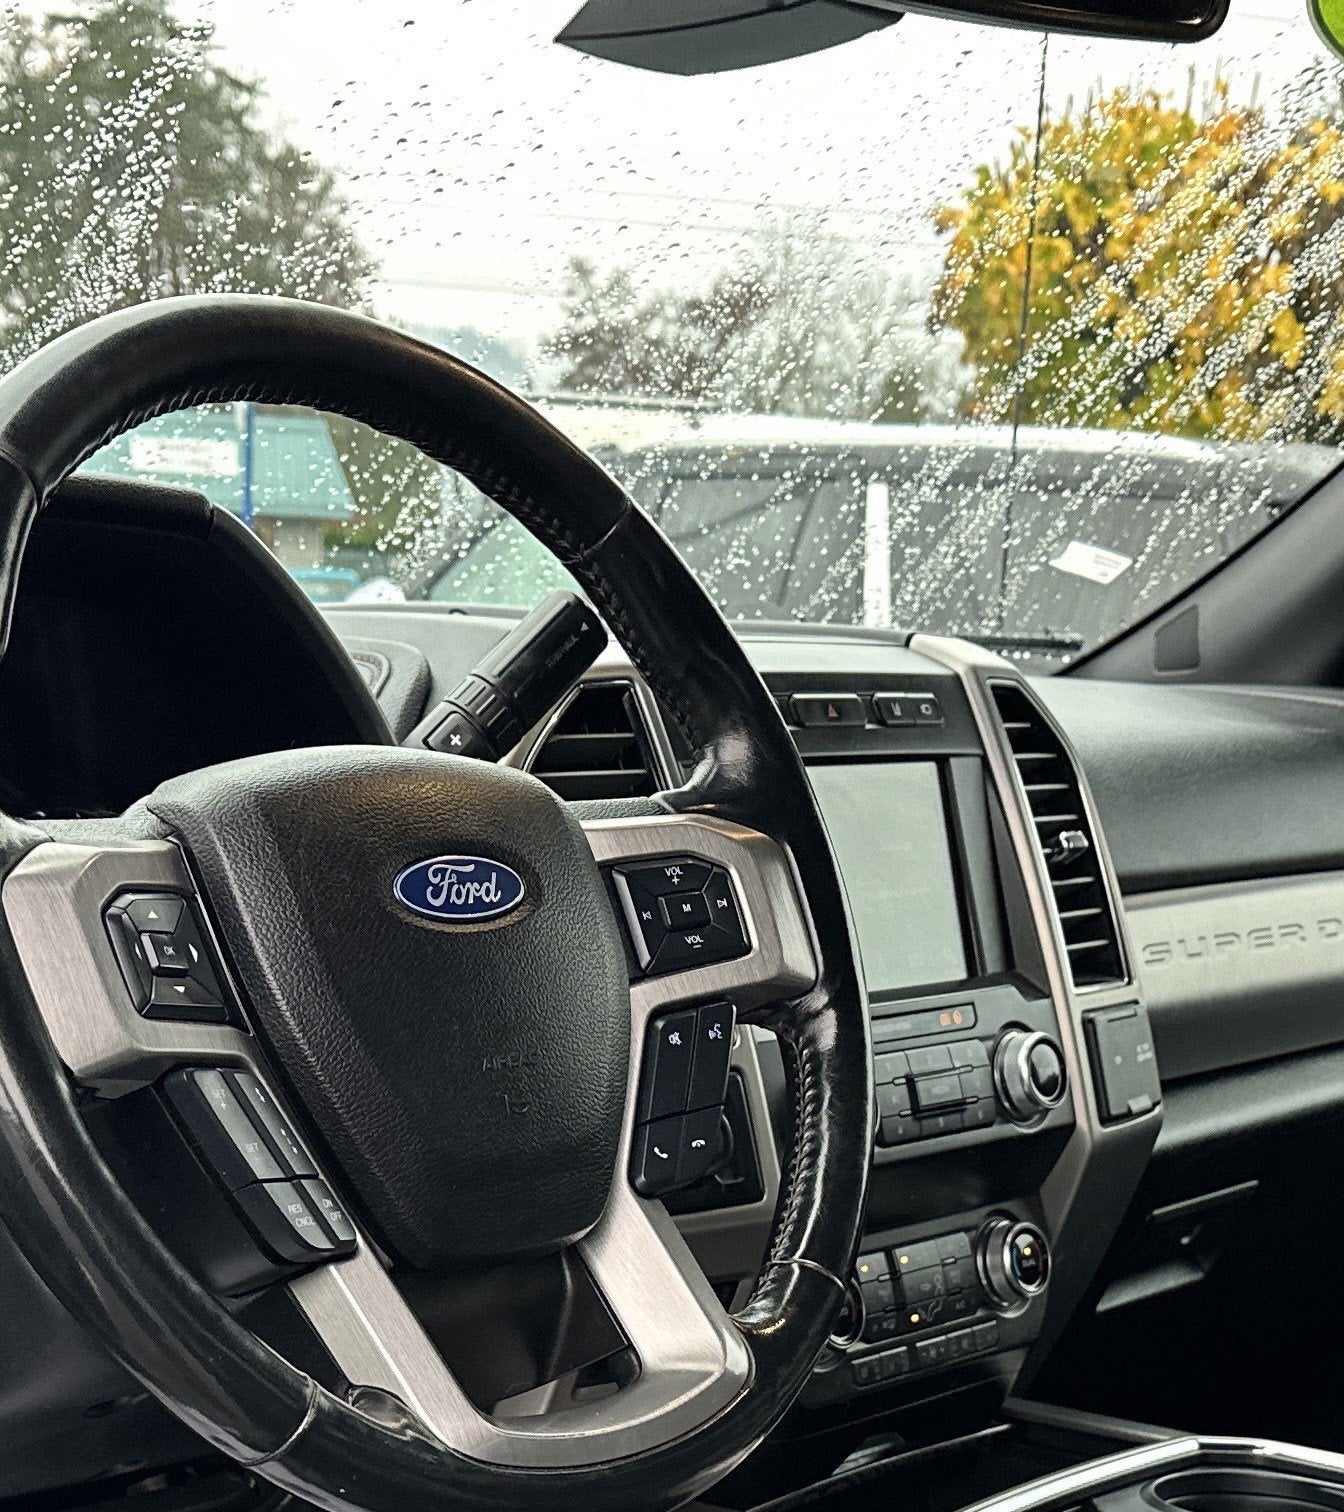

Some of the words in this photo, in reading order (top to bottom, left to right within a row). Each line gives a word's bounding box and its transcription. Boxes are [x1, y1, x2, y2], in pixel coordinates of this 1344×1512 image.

[665, 866, 684, 877] VOL
[426, 864, 501, 907] Ford
[682, 903, 692, 912] M
[684, 935, 704, 945] VOL
[1143, 922, 1307, 964] SUPER
[163, 945, 176, 955] OK
[288, 1203, 303, 1215] RES
